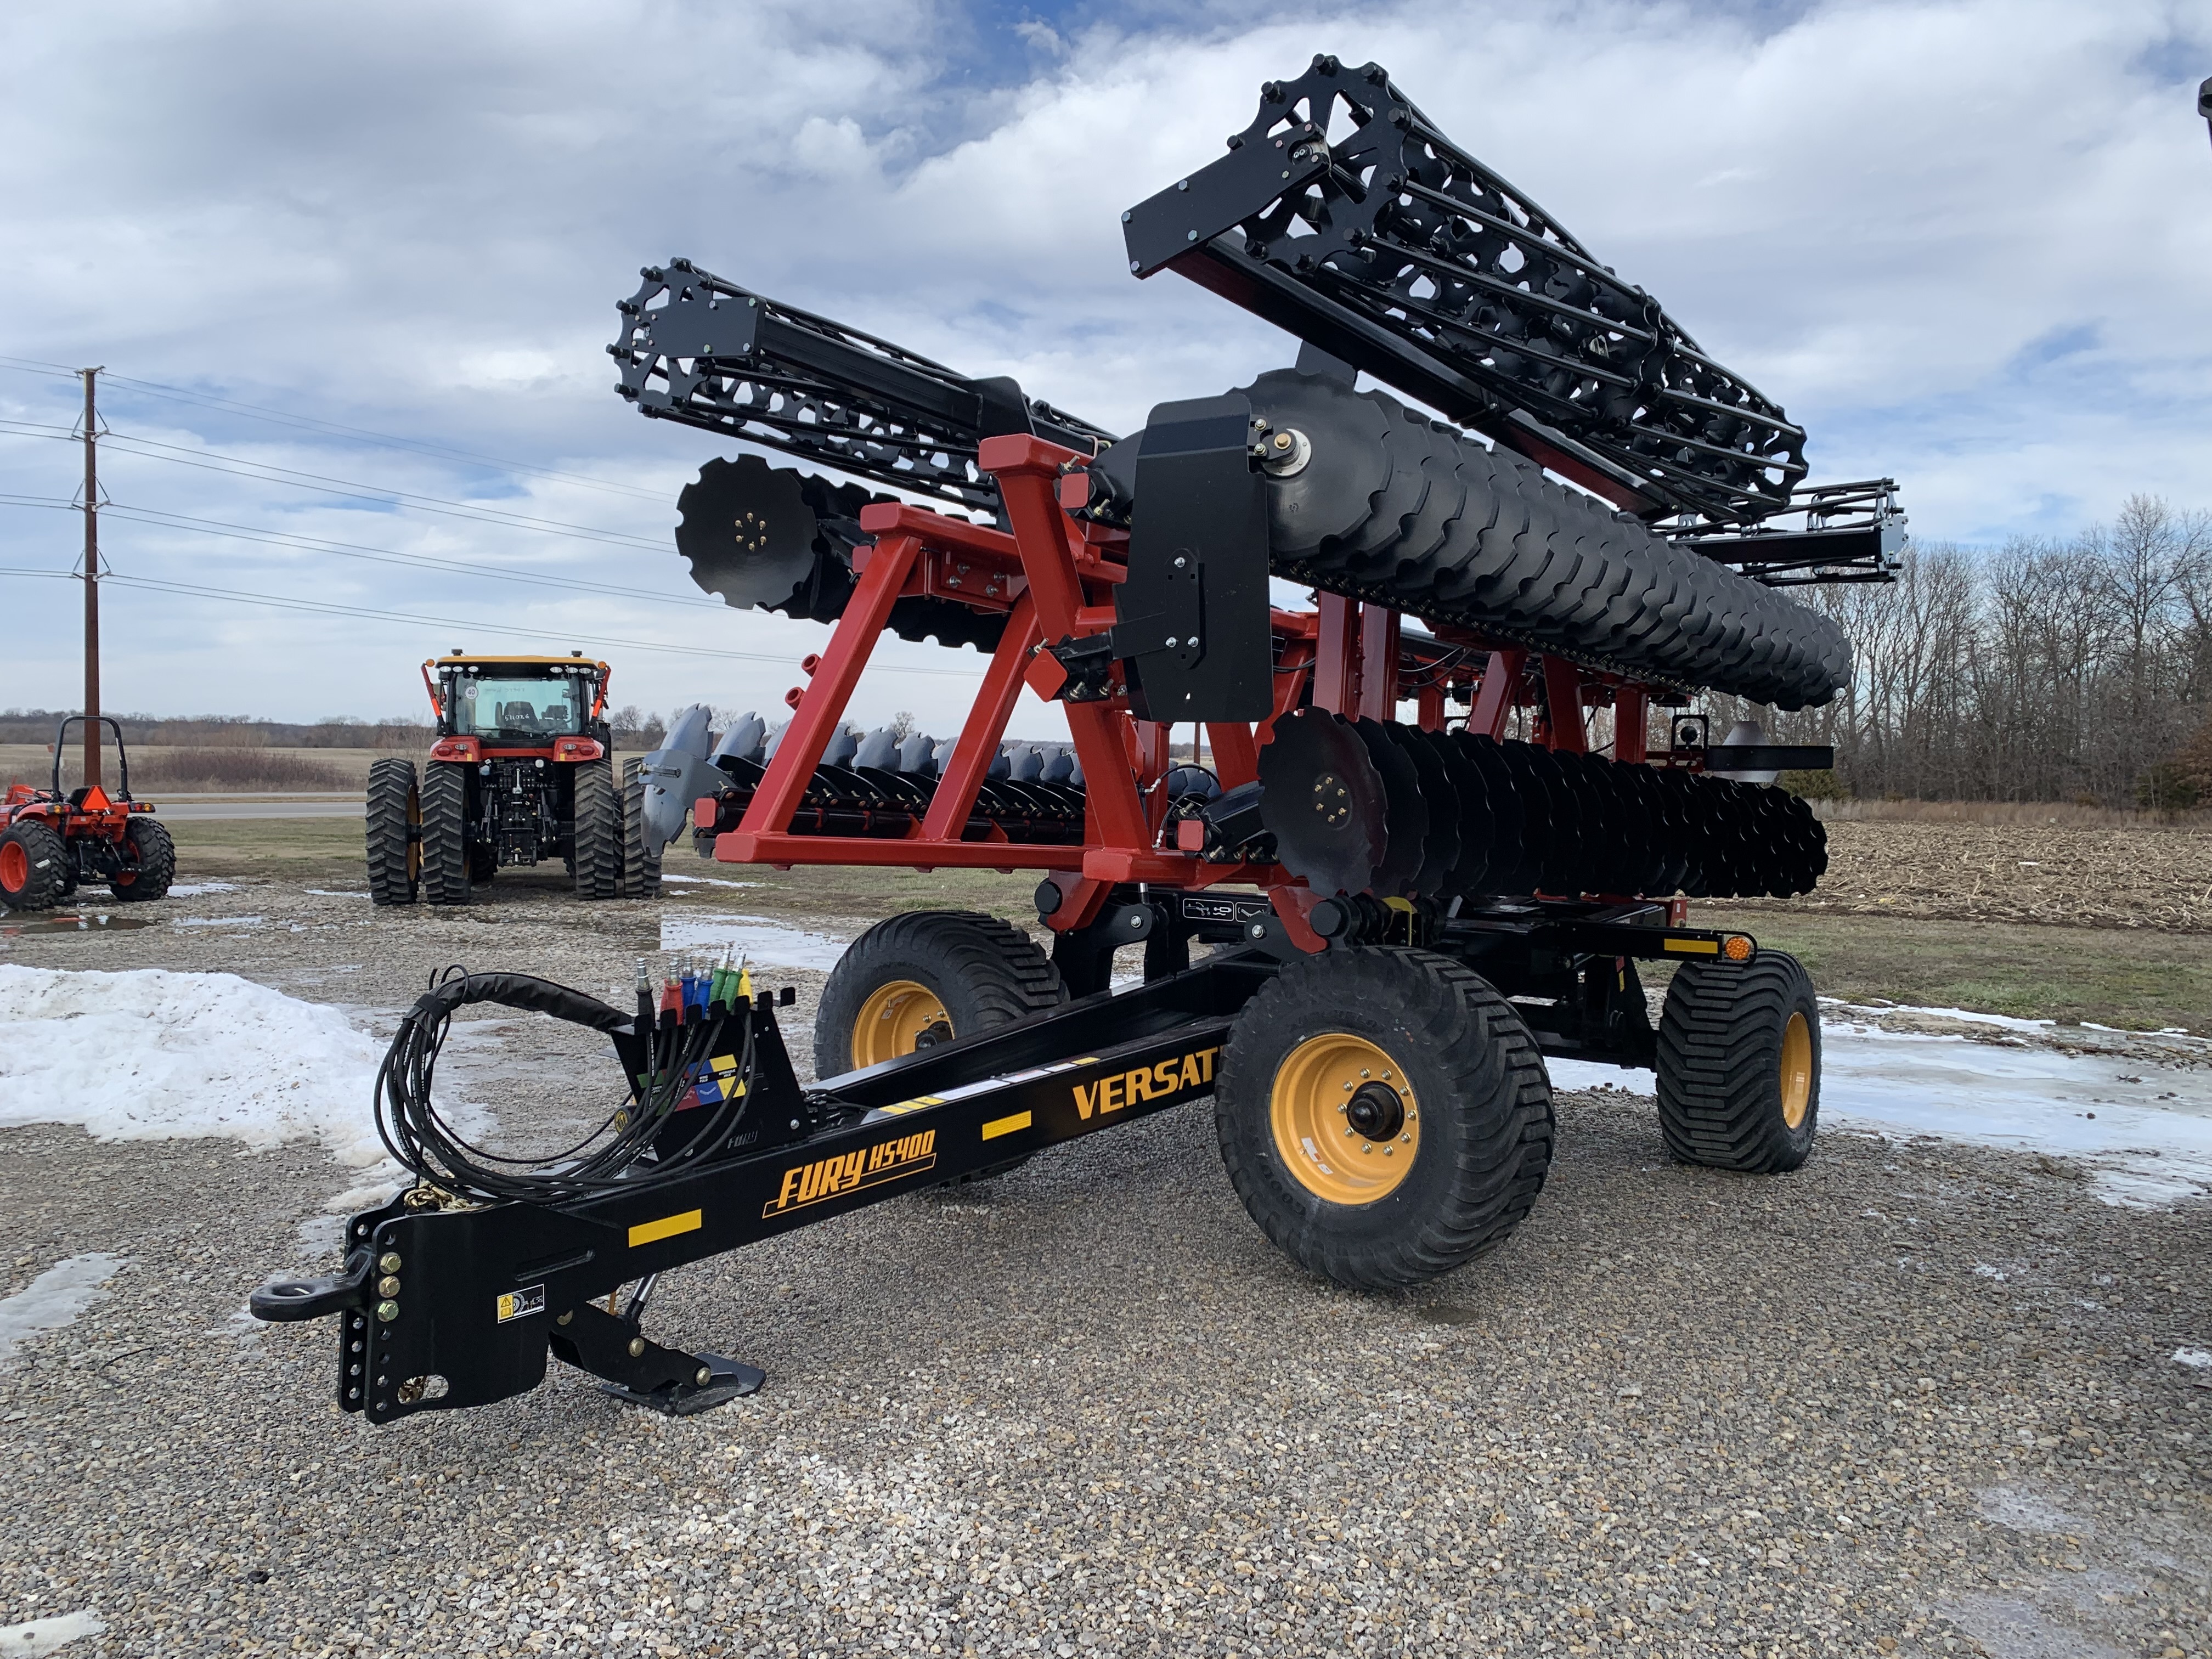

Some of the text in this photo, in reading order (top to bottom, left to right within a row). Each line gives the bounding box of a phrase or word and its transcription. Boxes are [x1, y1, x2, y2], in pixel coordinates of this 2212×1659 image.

[1073, 1045, 1224, 1120] VERSAT
[777, 1129, 936, 1209] FURY HS400
